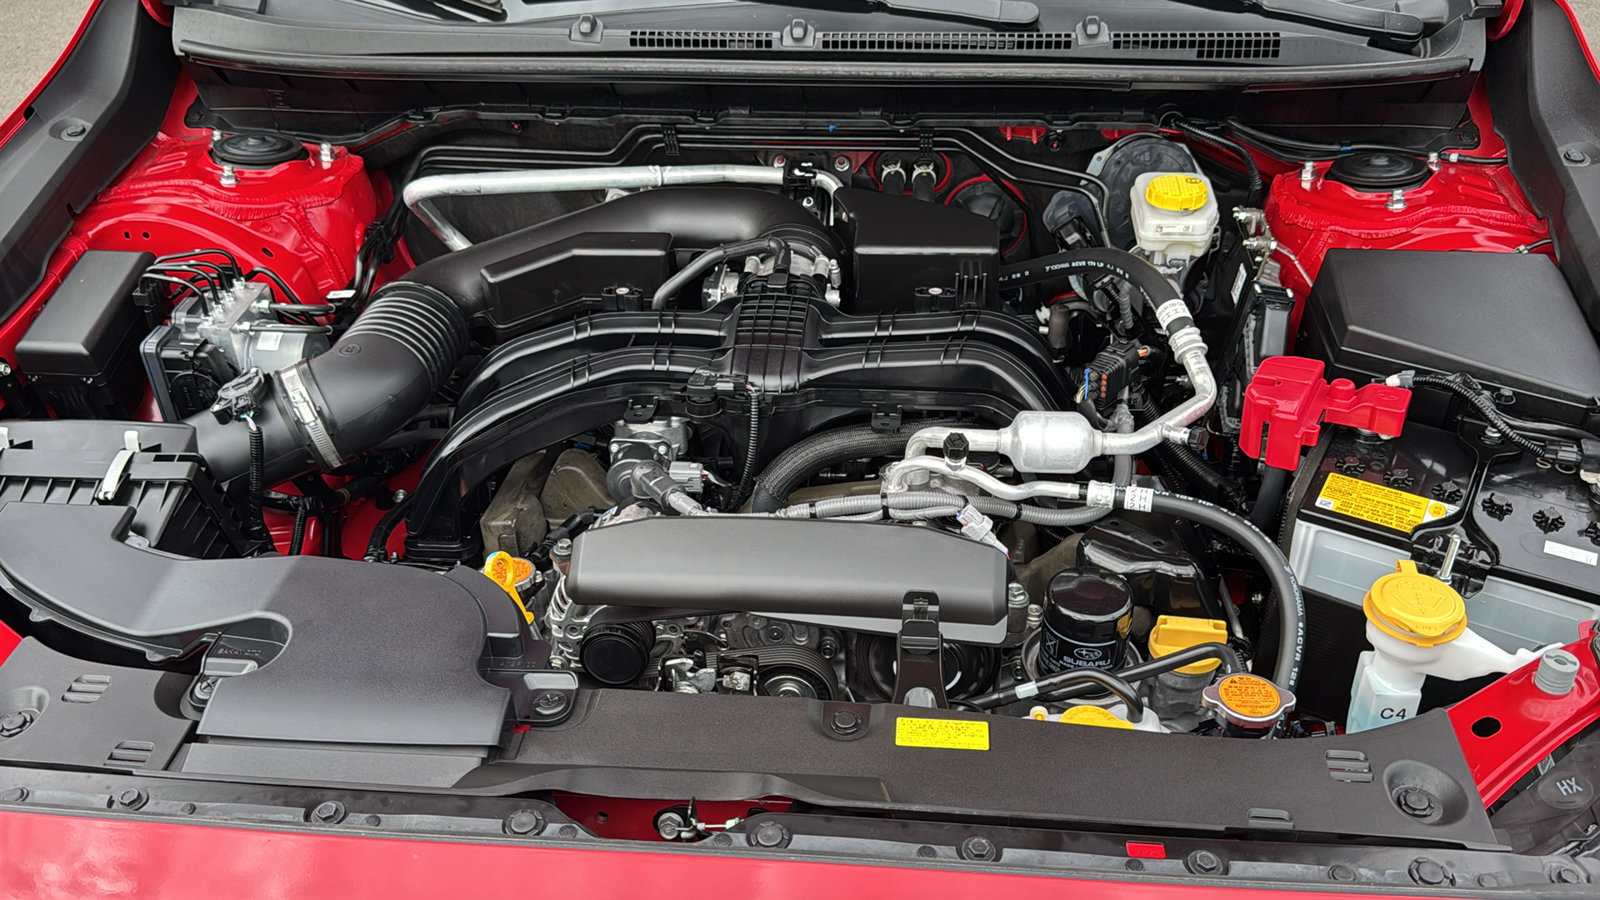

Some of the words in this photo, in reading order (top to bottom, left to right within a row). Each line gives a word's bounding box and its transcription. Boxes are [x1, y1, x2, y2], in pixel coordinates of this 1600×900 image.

[1365, 514, 1379, 522] CCA
[1063, 656, 1111, 667] SUBARU
[1380, 707, 1407, 720] C4
[1556, 776, 1583, 796] HX
